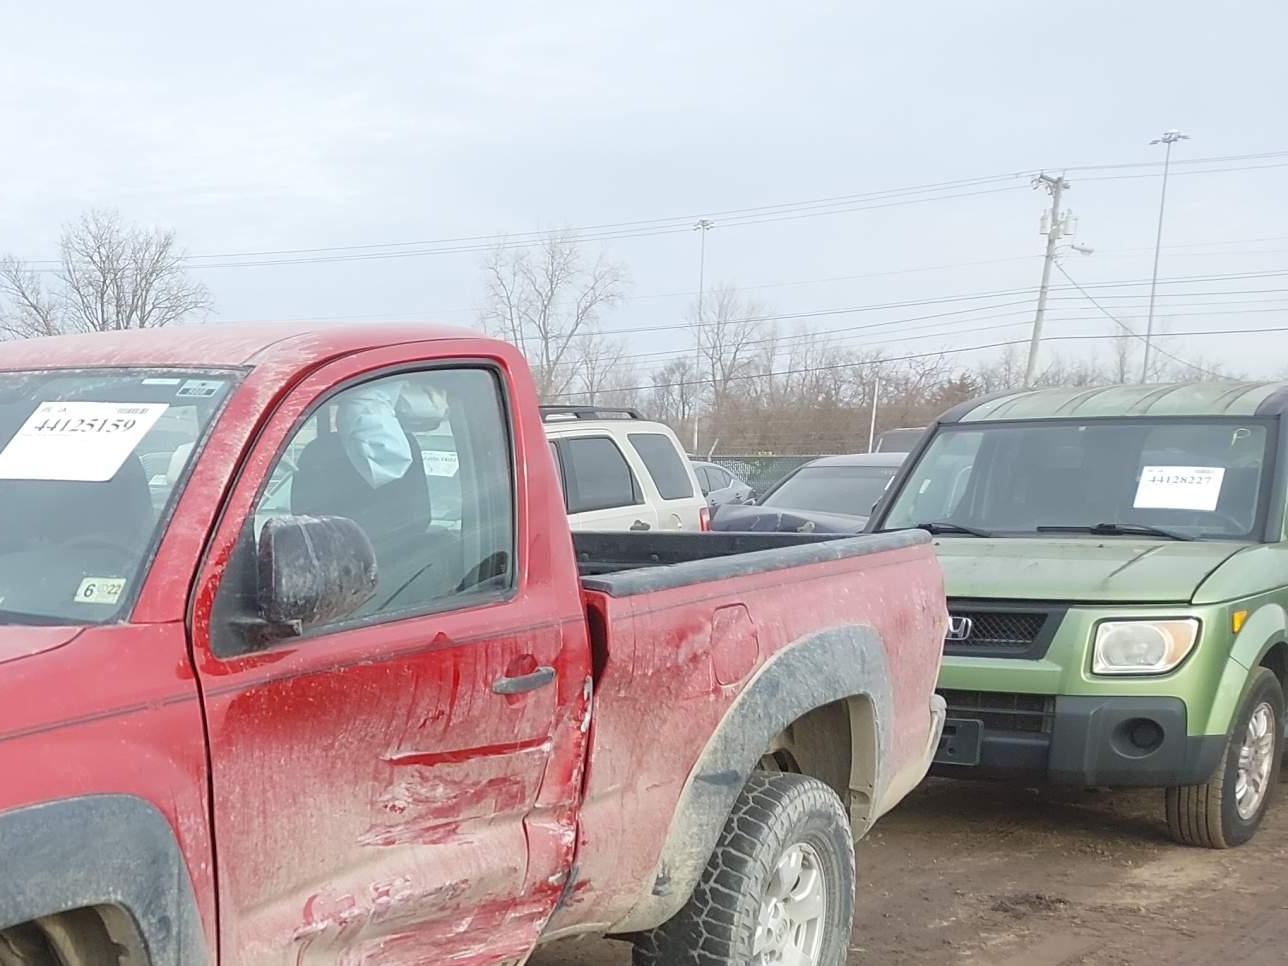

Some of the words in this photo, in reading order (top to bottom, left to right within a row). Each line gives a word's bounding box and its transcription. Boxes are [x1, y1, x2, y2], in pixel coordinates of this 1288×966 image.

[34, 418, 137, 433] 44125159
[1149, 476, 1213, 485] 44128227
[84, 583, 97, 598] 6
